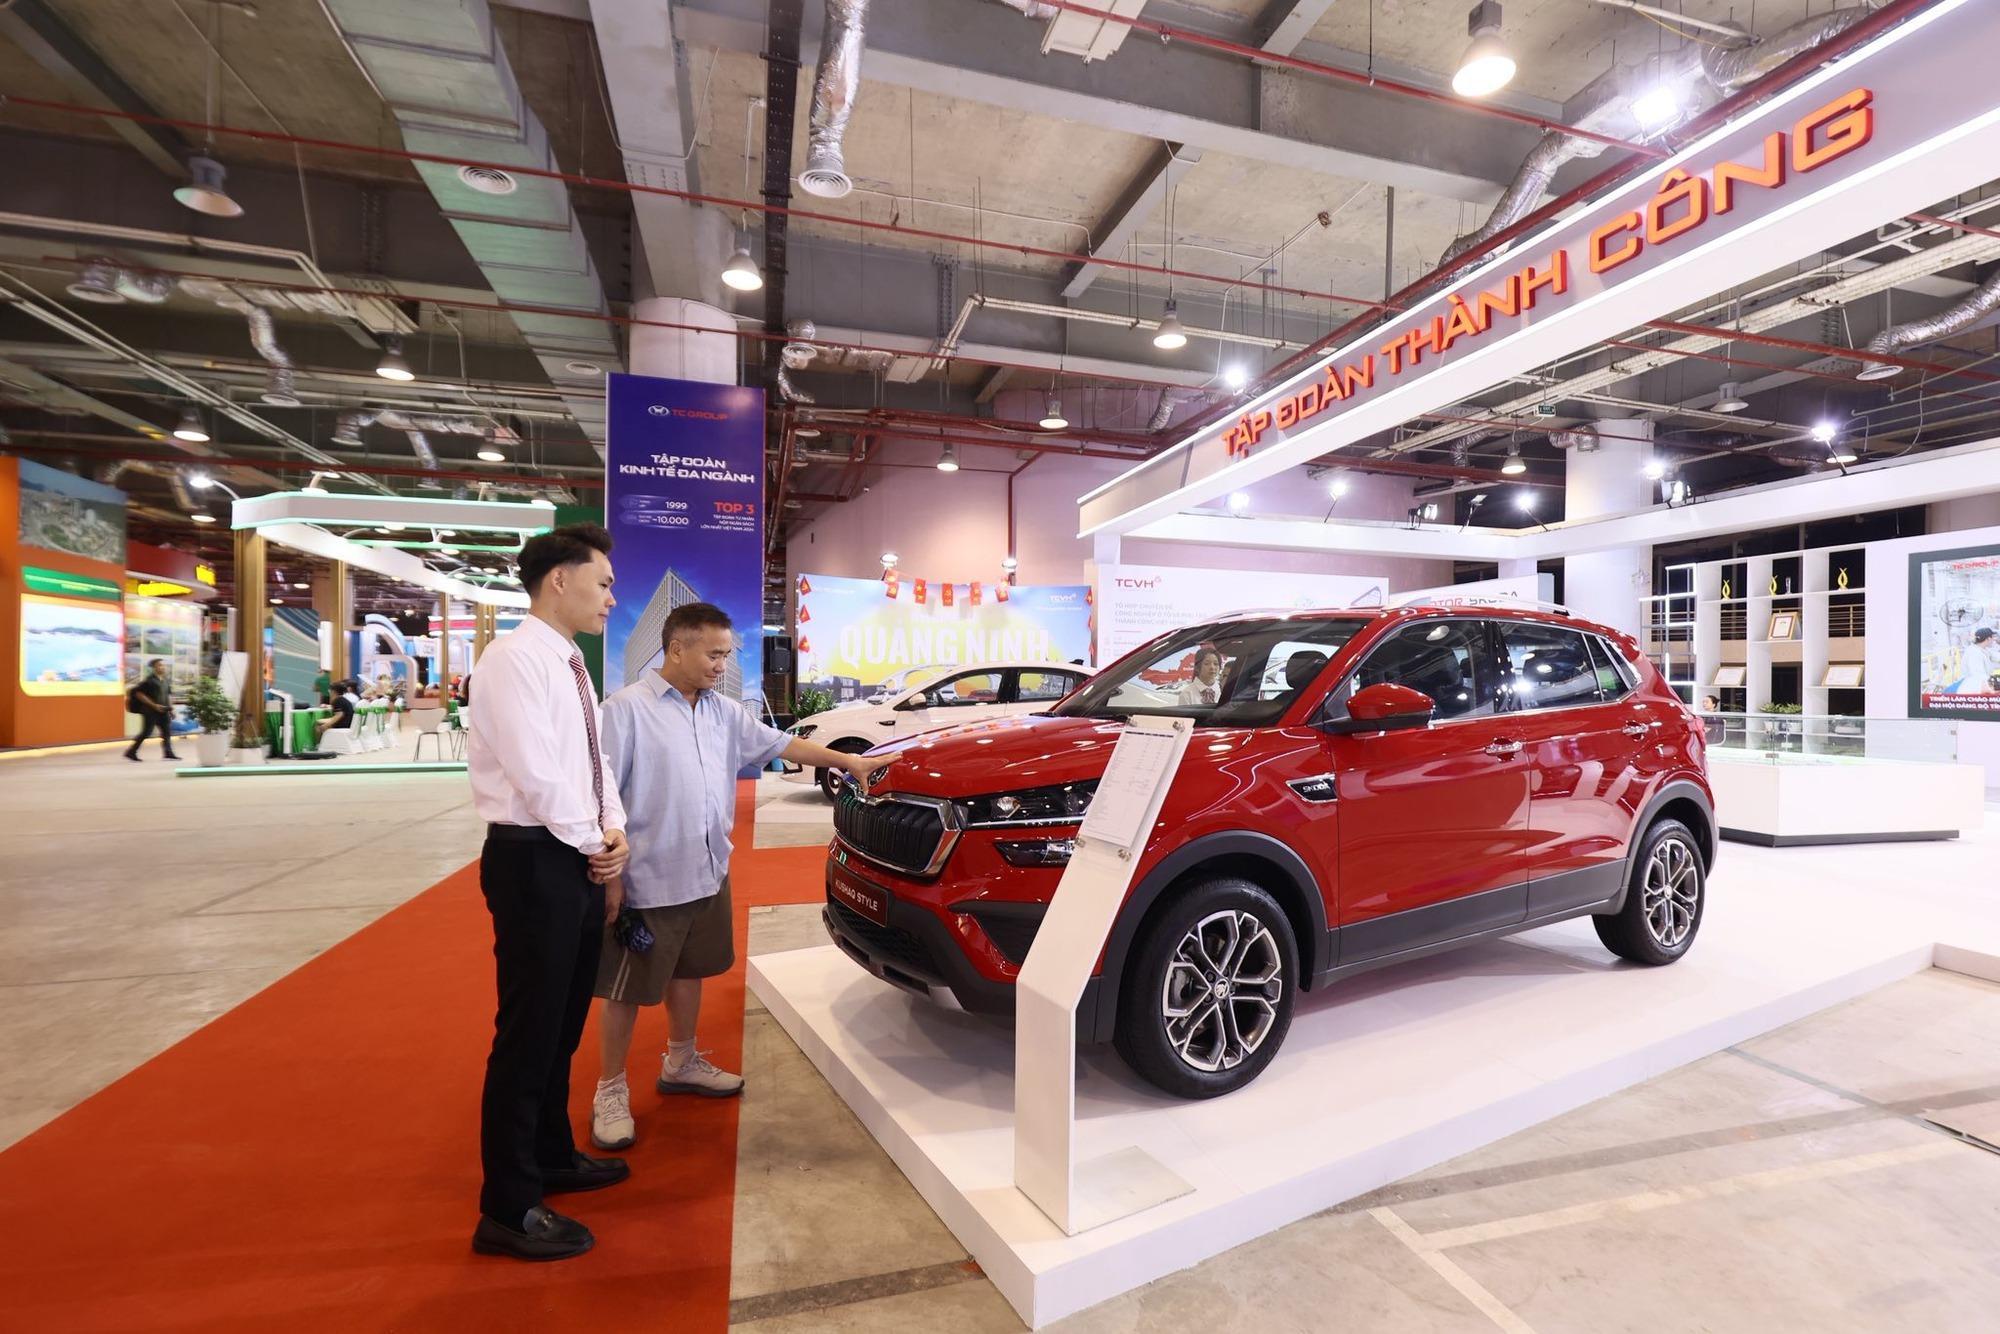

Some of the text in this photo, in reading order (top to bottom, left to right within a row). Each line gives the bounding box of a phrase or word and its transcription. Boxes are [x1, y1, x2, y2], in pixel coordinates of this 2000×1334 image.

[1222, 87, 1873, 457] TẬP ĐOÀN THÀNH CÔNG
[672, 409, 728, 421] TC GROUP
[651, 453, 726, 469] TẬP ĐOÀN
[619, 464, 755, 483] KINH TẾ ĐA NGÀNH
[665, 501, 688, 510] 1999
[714, 501, 755, 514] TOP 3
[1115, 578, 1154, 588] TCVH
[840, 619, 1049, 669] QUẢNG NINH
[857, 892, 878, 911] STYLE
